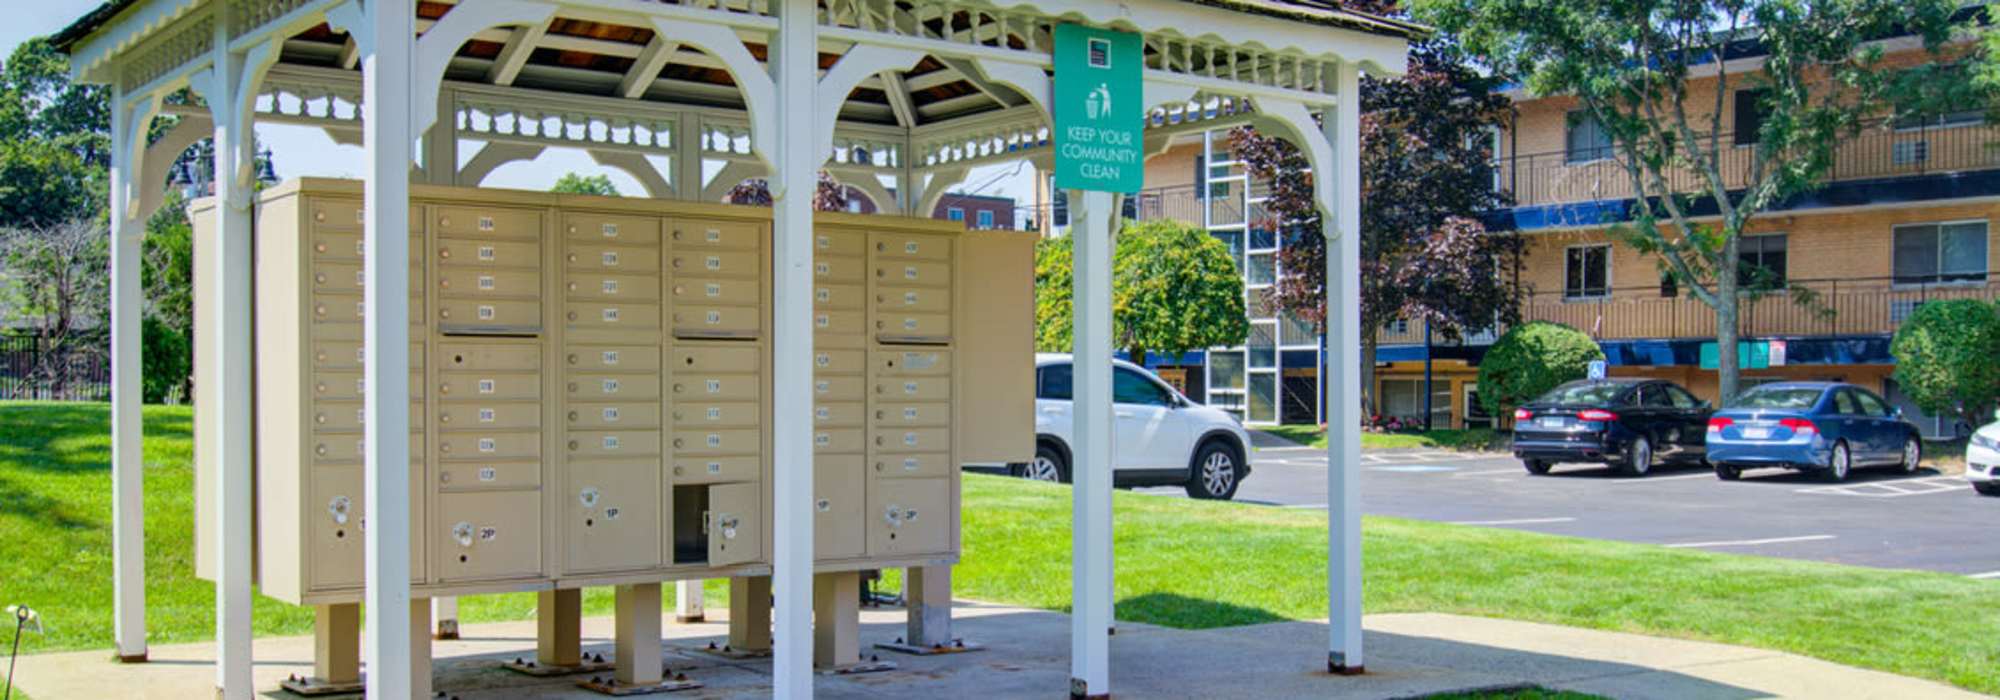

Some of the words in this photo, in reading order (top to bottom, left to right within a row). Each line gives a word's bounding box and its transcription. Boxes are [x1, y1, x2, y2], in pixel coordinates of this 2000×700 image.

[1067, 126, 1096, 141] KEEP
[1098, 127, 1132, 145] YOUR
[1062, 143, 1137, 163] COMMUNITY
[1080, 163, 1120, 180] CLEAN
[605, 507, 619, 519] 1P
[480, 527, 496, 540] 2P
